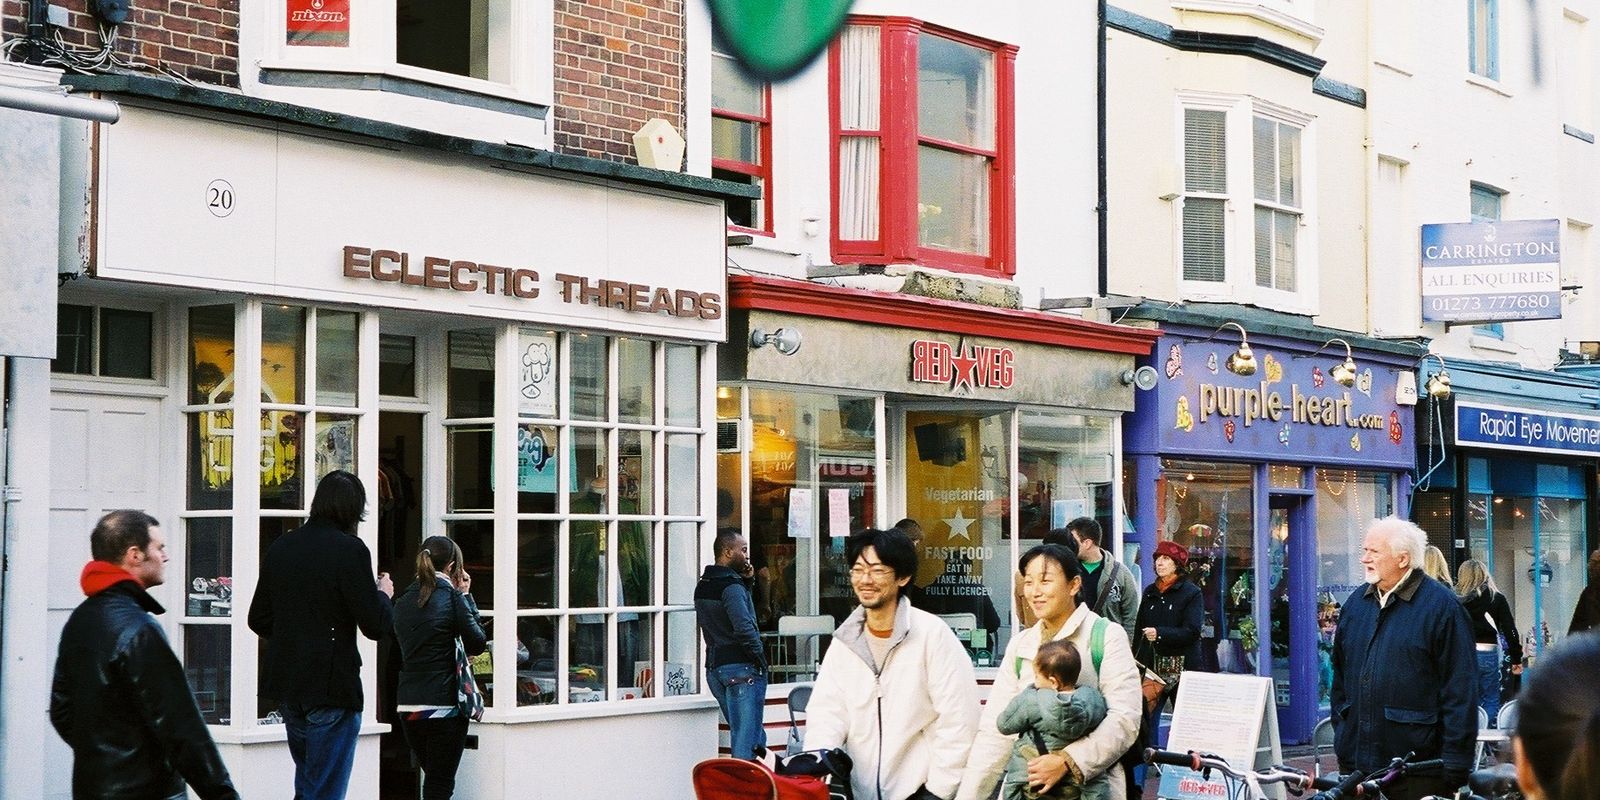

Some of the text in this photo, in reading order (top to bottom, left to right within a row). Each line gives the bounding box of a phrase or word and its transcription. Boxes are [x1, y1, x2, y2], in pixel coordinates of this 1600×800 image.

[292, 10, 345, 22] nixon
[210, 187, 233, 210] 20
[1425, 241, 1557, 260] CARRINGTON
[343, 245, 722, 321] ECLECTIC THREADS
[1428, 271, 1554, 288] ALL ENQUIRIES
[1432, 294, 1550, 311] 01273 777680
[975, 346, 1014, 388] VEG
[1480, 412, 1516, 441] Rapid
[1521, 416, 1542, 443] Eye
[925, 487, 994, 503] Vegetarian
[925, 547, 993, 560] FAST FOOD
[946, 564, 973, 574] EAT IN
[937, 576, 982, 584] TAKE AWAY
[925, 588, 951, 596] FULLY
